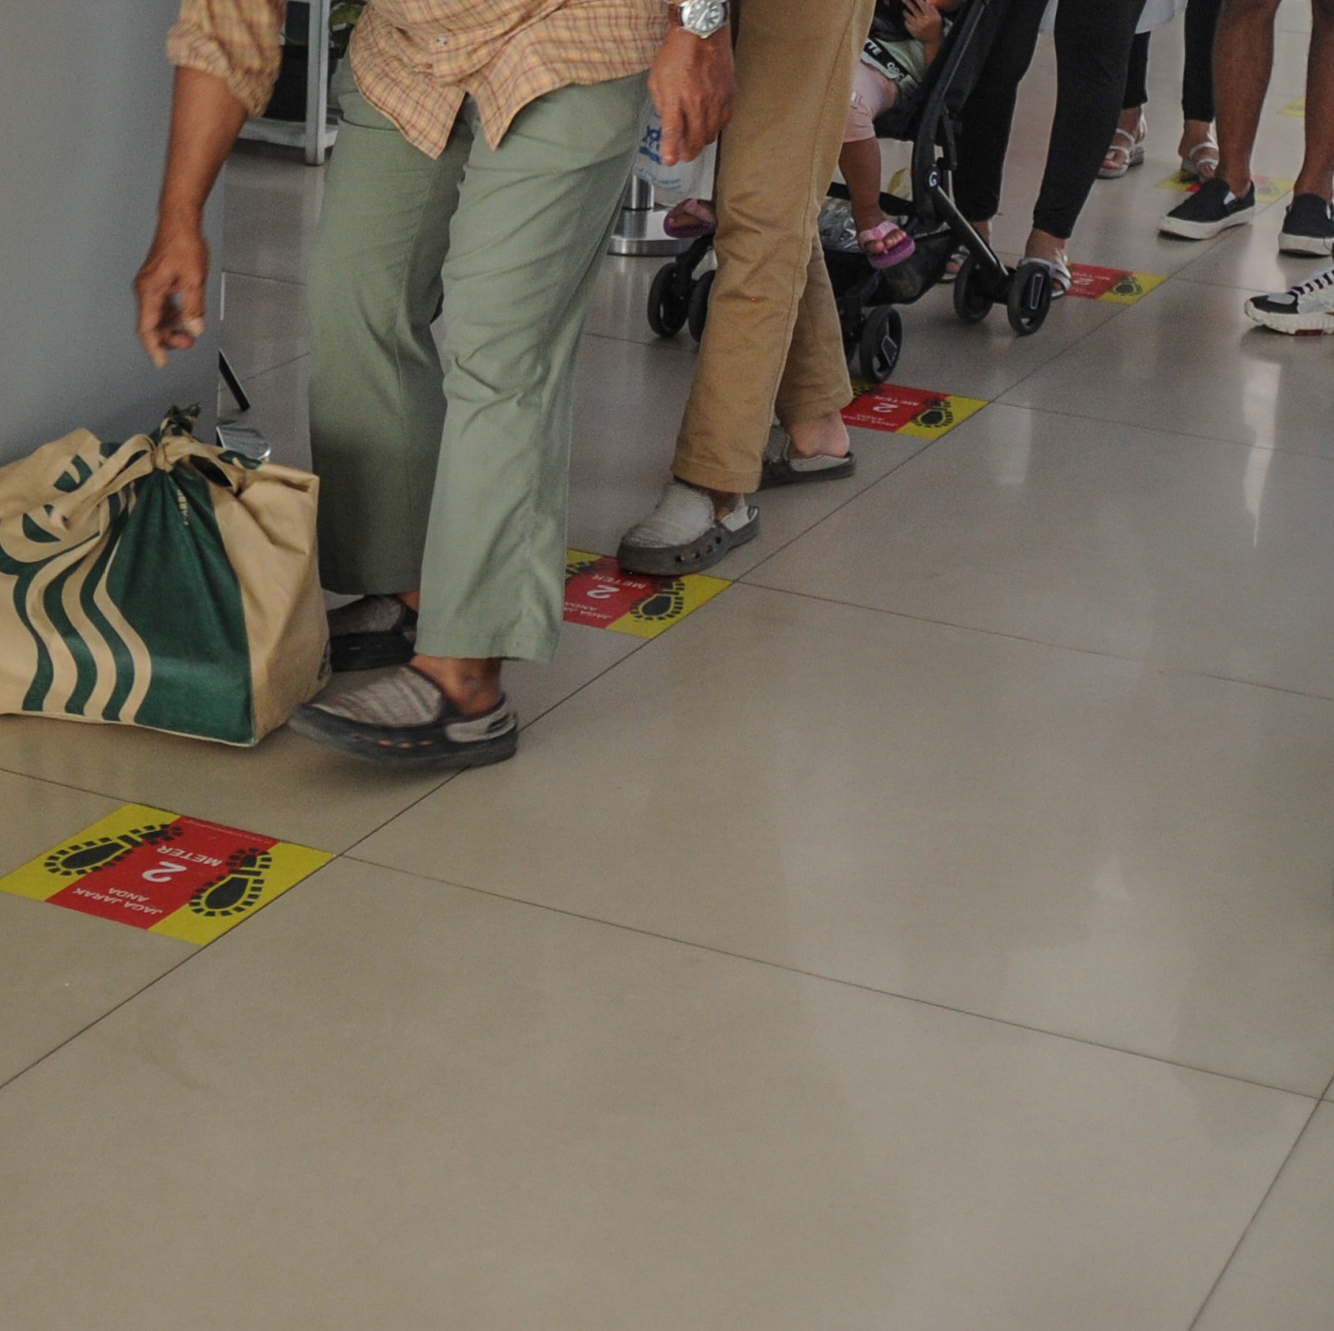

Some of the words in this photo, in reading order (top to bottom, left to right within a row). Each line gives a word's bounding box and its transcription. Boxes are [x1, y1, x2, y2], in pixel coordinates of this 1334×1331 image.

[873, 402, 899, 413] 2
[592, 573, 647, 590] METER
[587, 584, 620, 600] 2
[157, 845, 223, 867] METER
[141, 861, 187, 883] 2
[71, 887, 119, 904] JARAK
[108, 887, 150, 903] ANDA
[123, 900, 163, 917] JAGA
